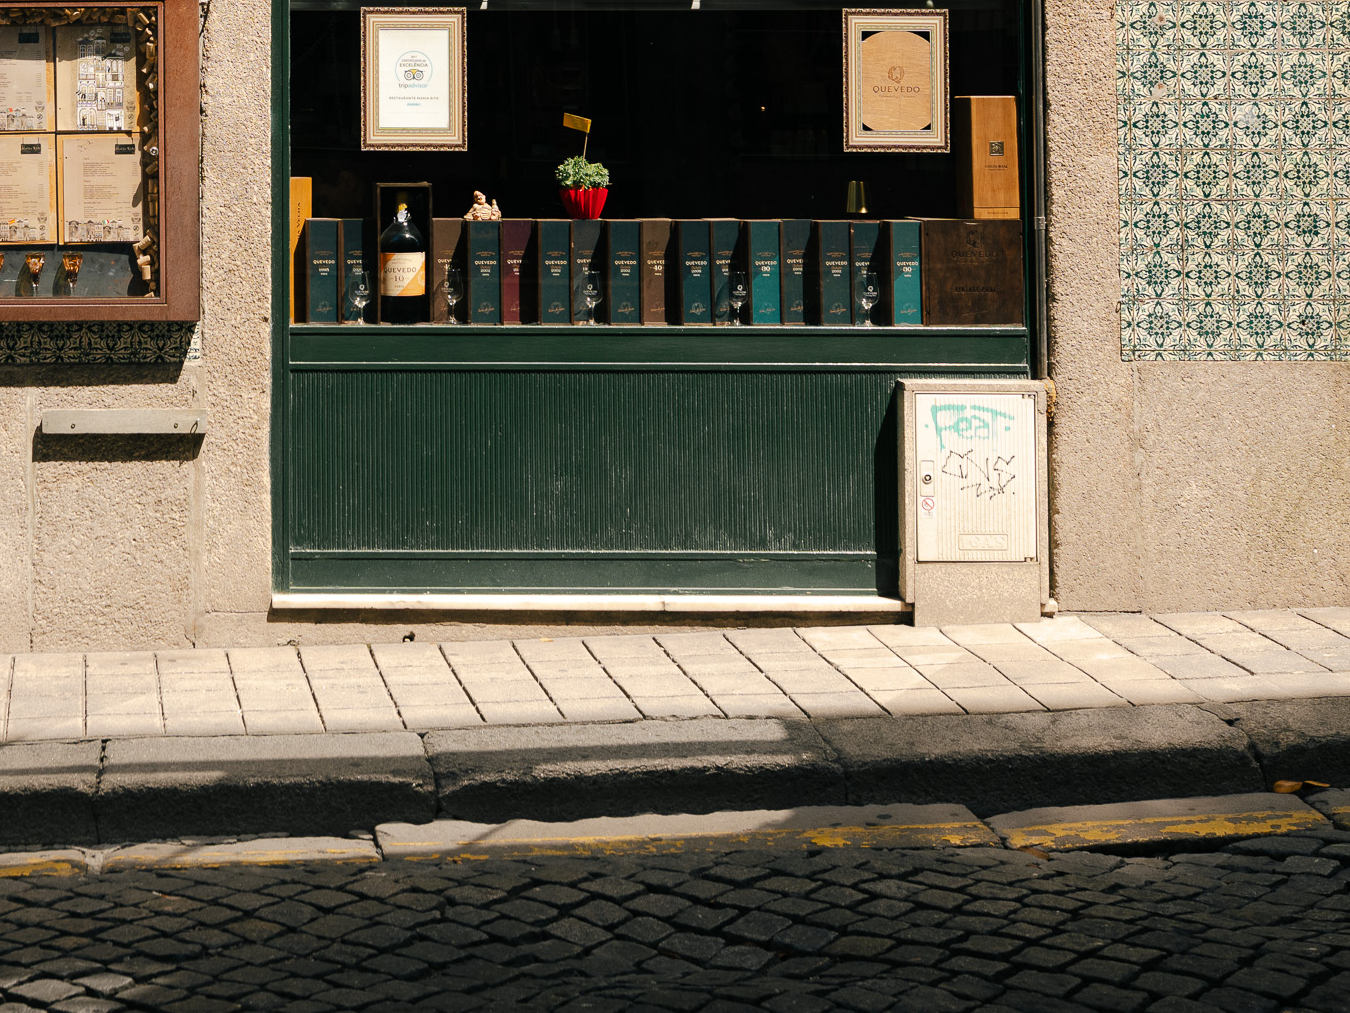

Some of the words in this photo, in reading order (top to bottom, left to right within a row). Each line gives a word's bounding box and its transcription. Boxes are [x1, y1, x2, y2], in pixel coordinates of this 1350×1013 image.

[872, 85, 921, 94] QUEVEDO
[950, 250, 999, 259] QUEVEDO
[384, 266, 417, 274] QUEVEDO
